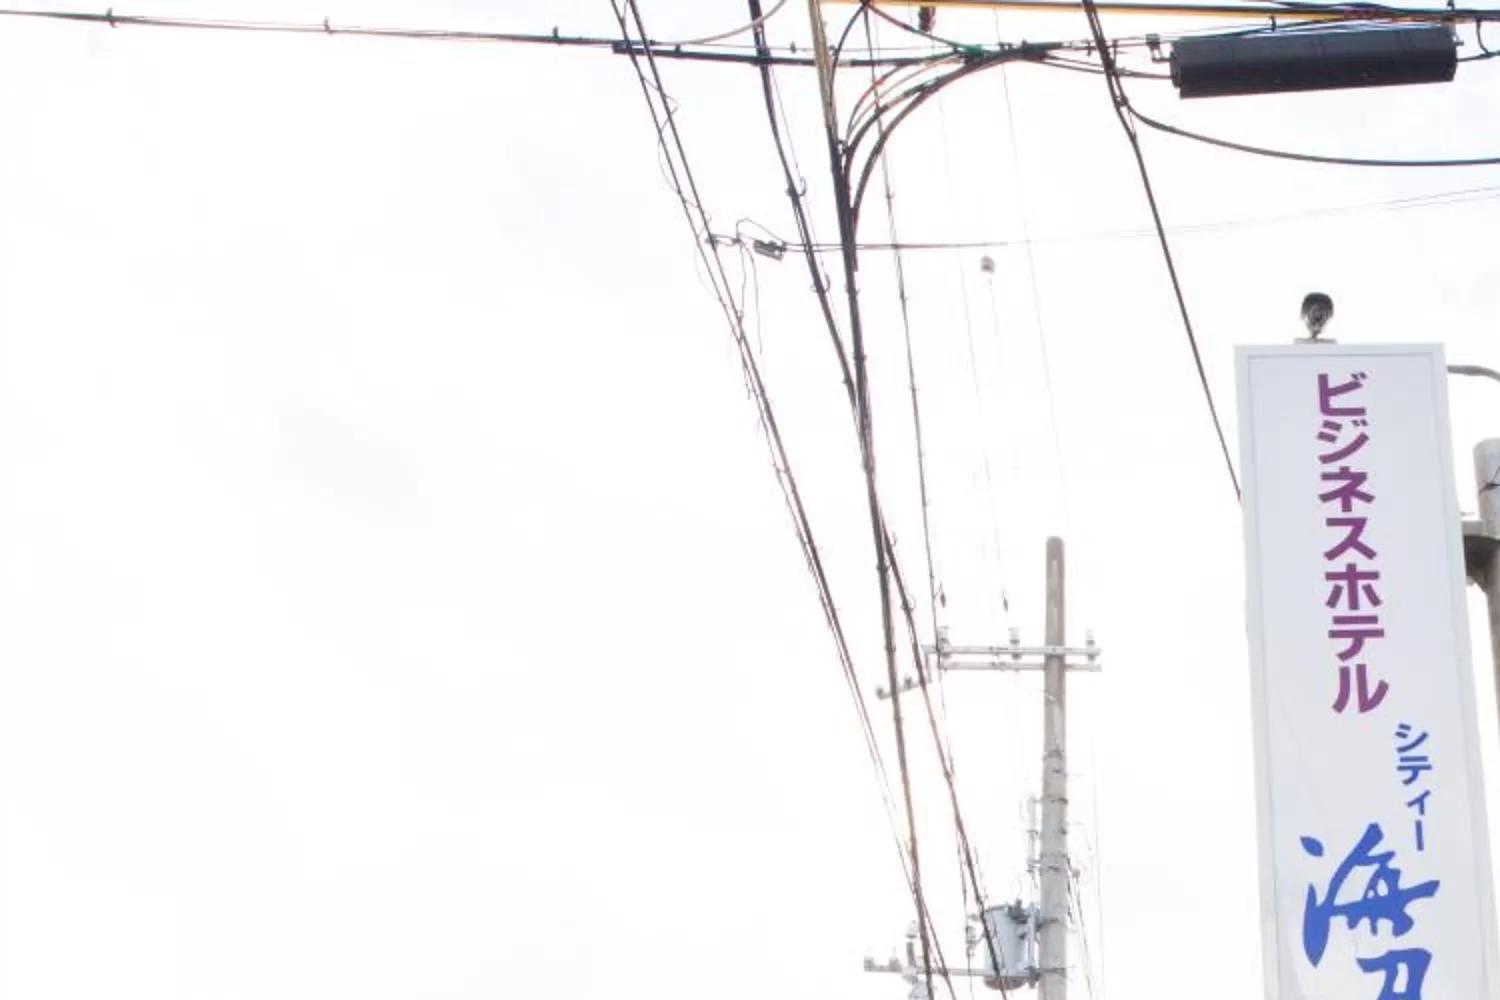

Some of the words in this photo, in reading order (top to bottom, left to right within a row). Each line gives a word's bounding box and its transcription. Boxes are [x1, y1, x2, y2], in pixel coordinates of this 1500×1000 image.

[1316, 371, 1390, 714] ビジネスホテル
[1394, 722, 1433, 851] シティー
